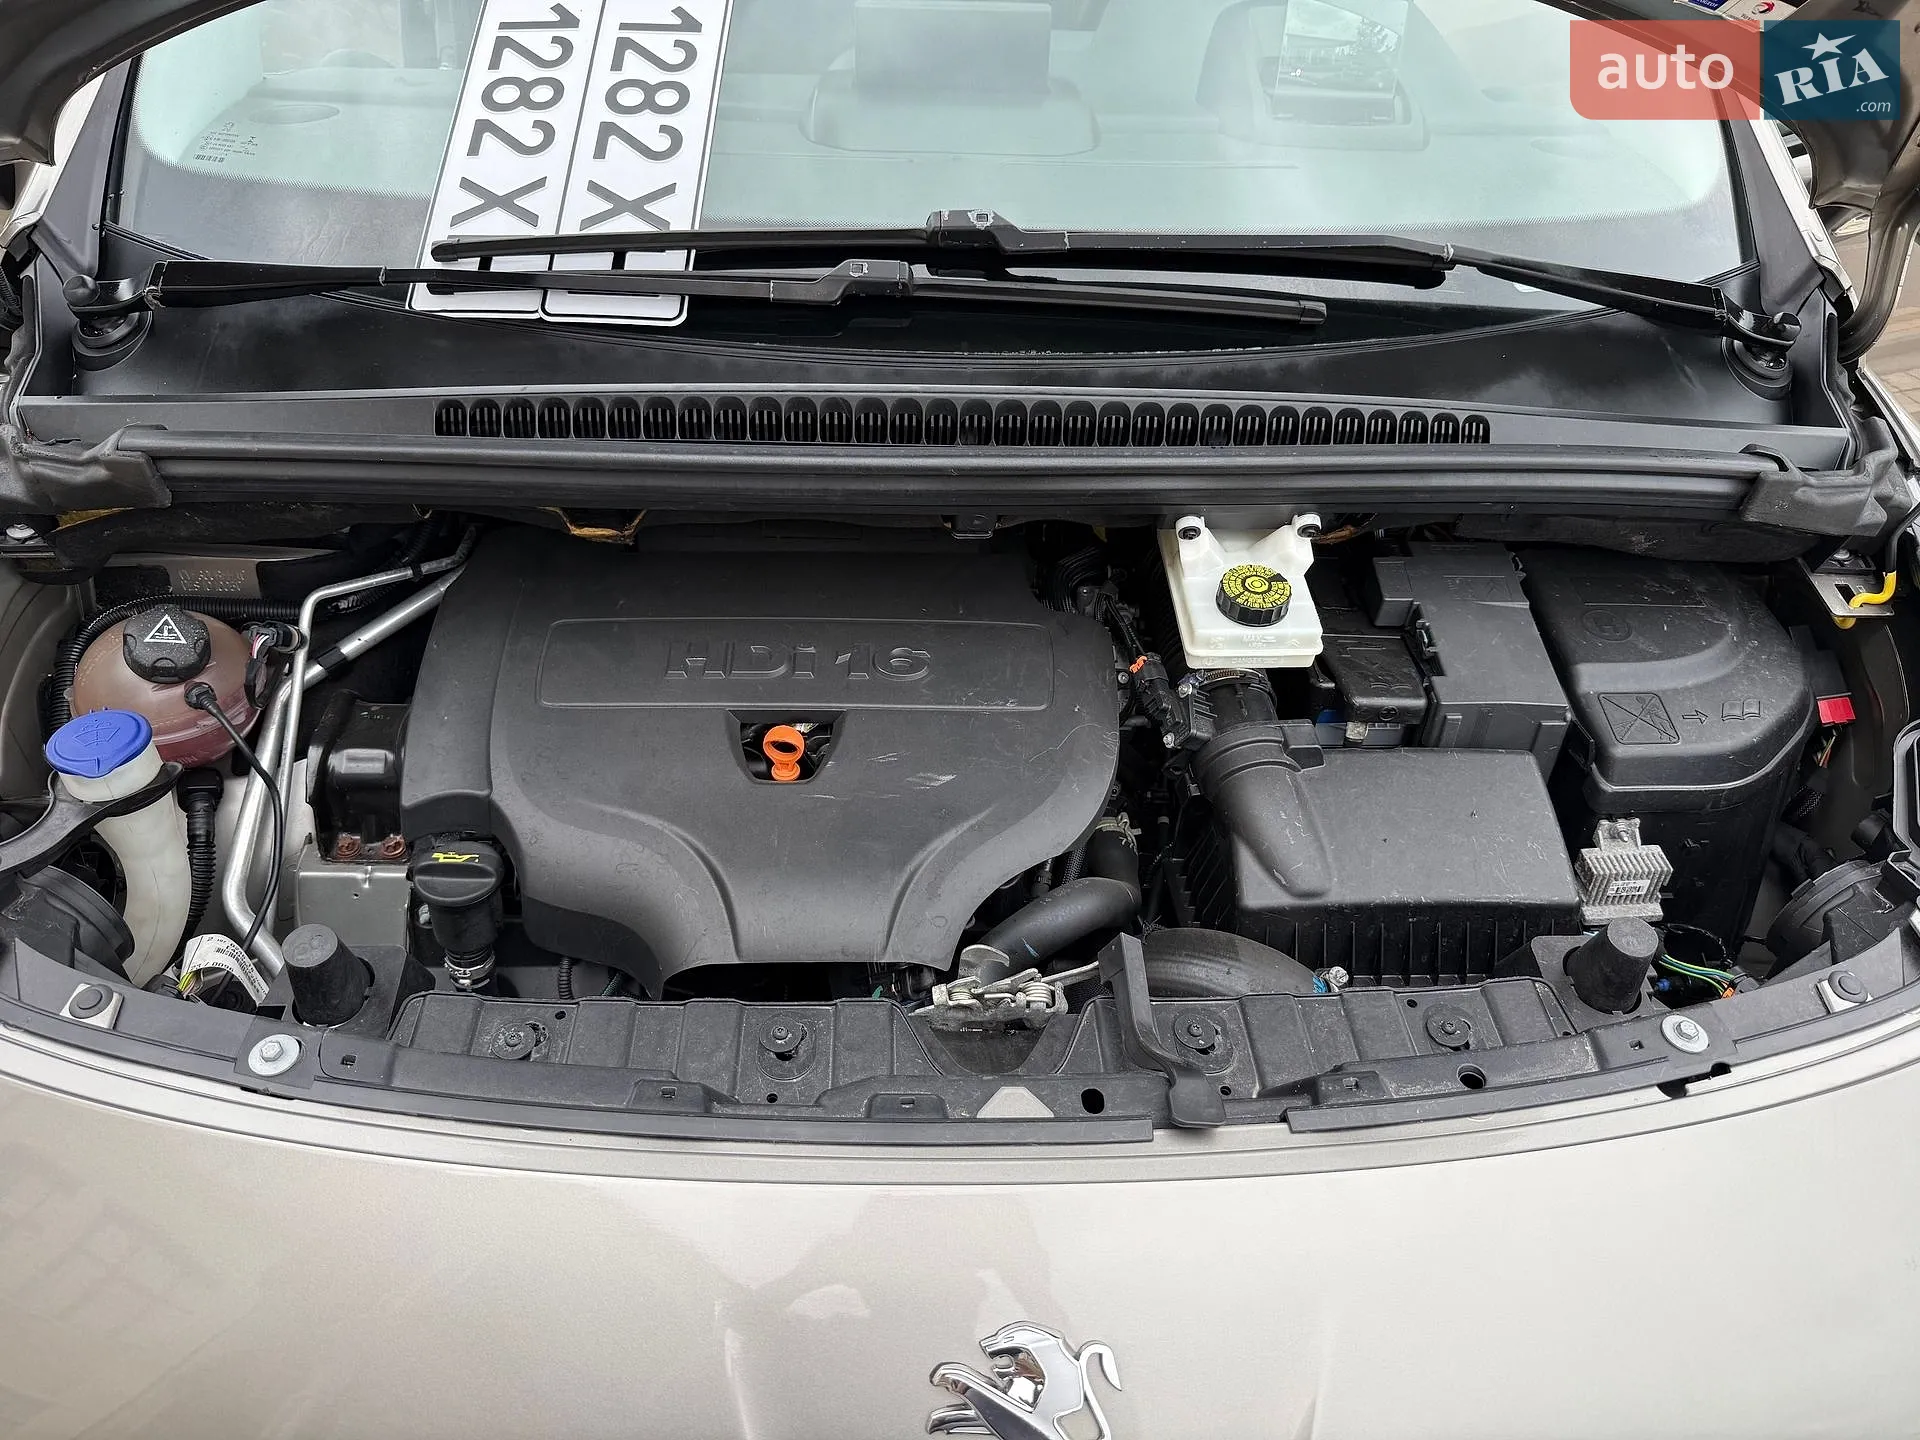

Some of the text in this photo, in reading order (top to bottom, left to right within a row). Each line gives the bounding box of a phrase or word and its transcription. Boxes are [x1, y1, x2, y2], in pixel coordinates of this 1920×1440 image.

[467, 3, 580, 157] 1282
[593, 6, 703, 160] 1282
[664, 641, 931, 681] HDi 16
